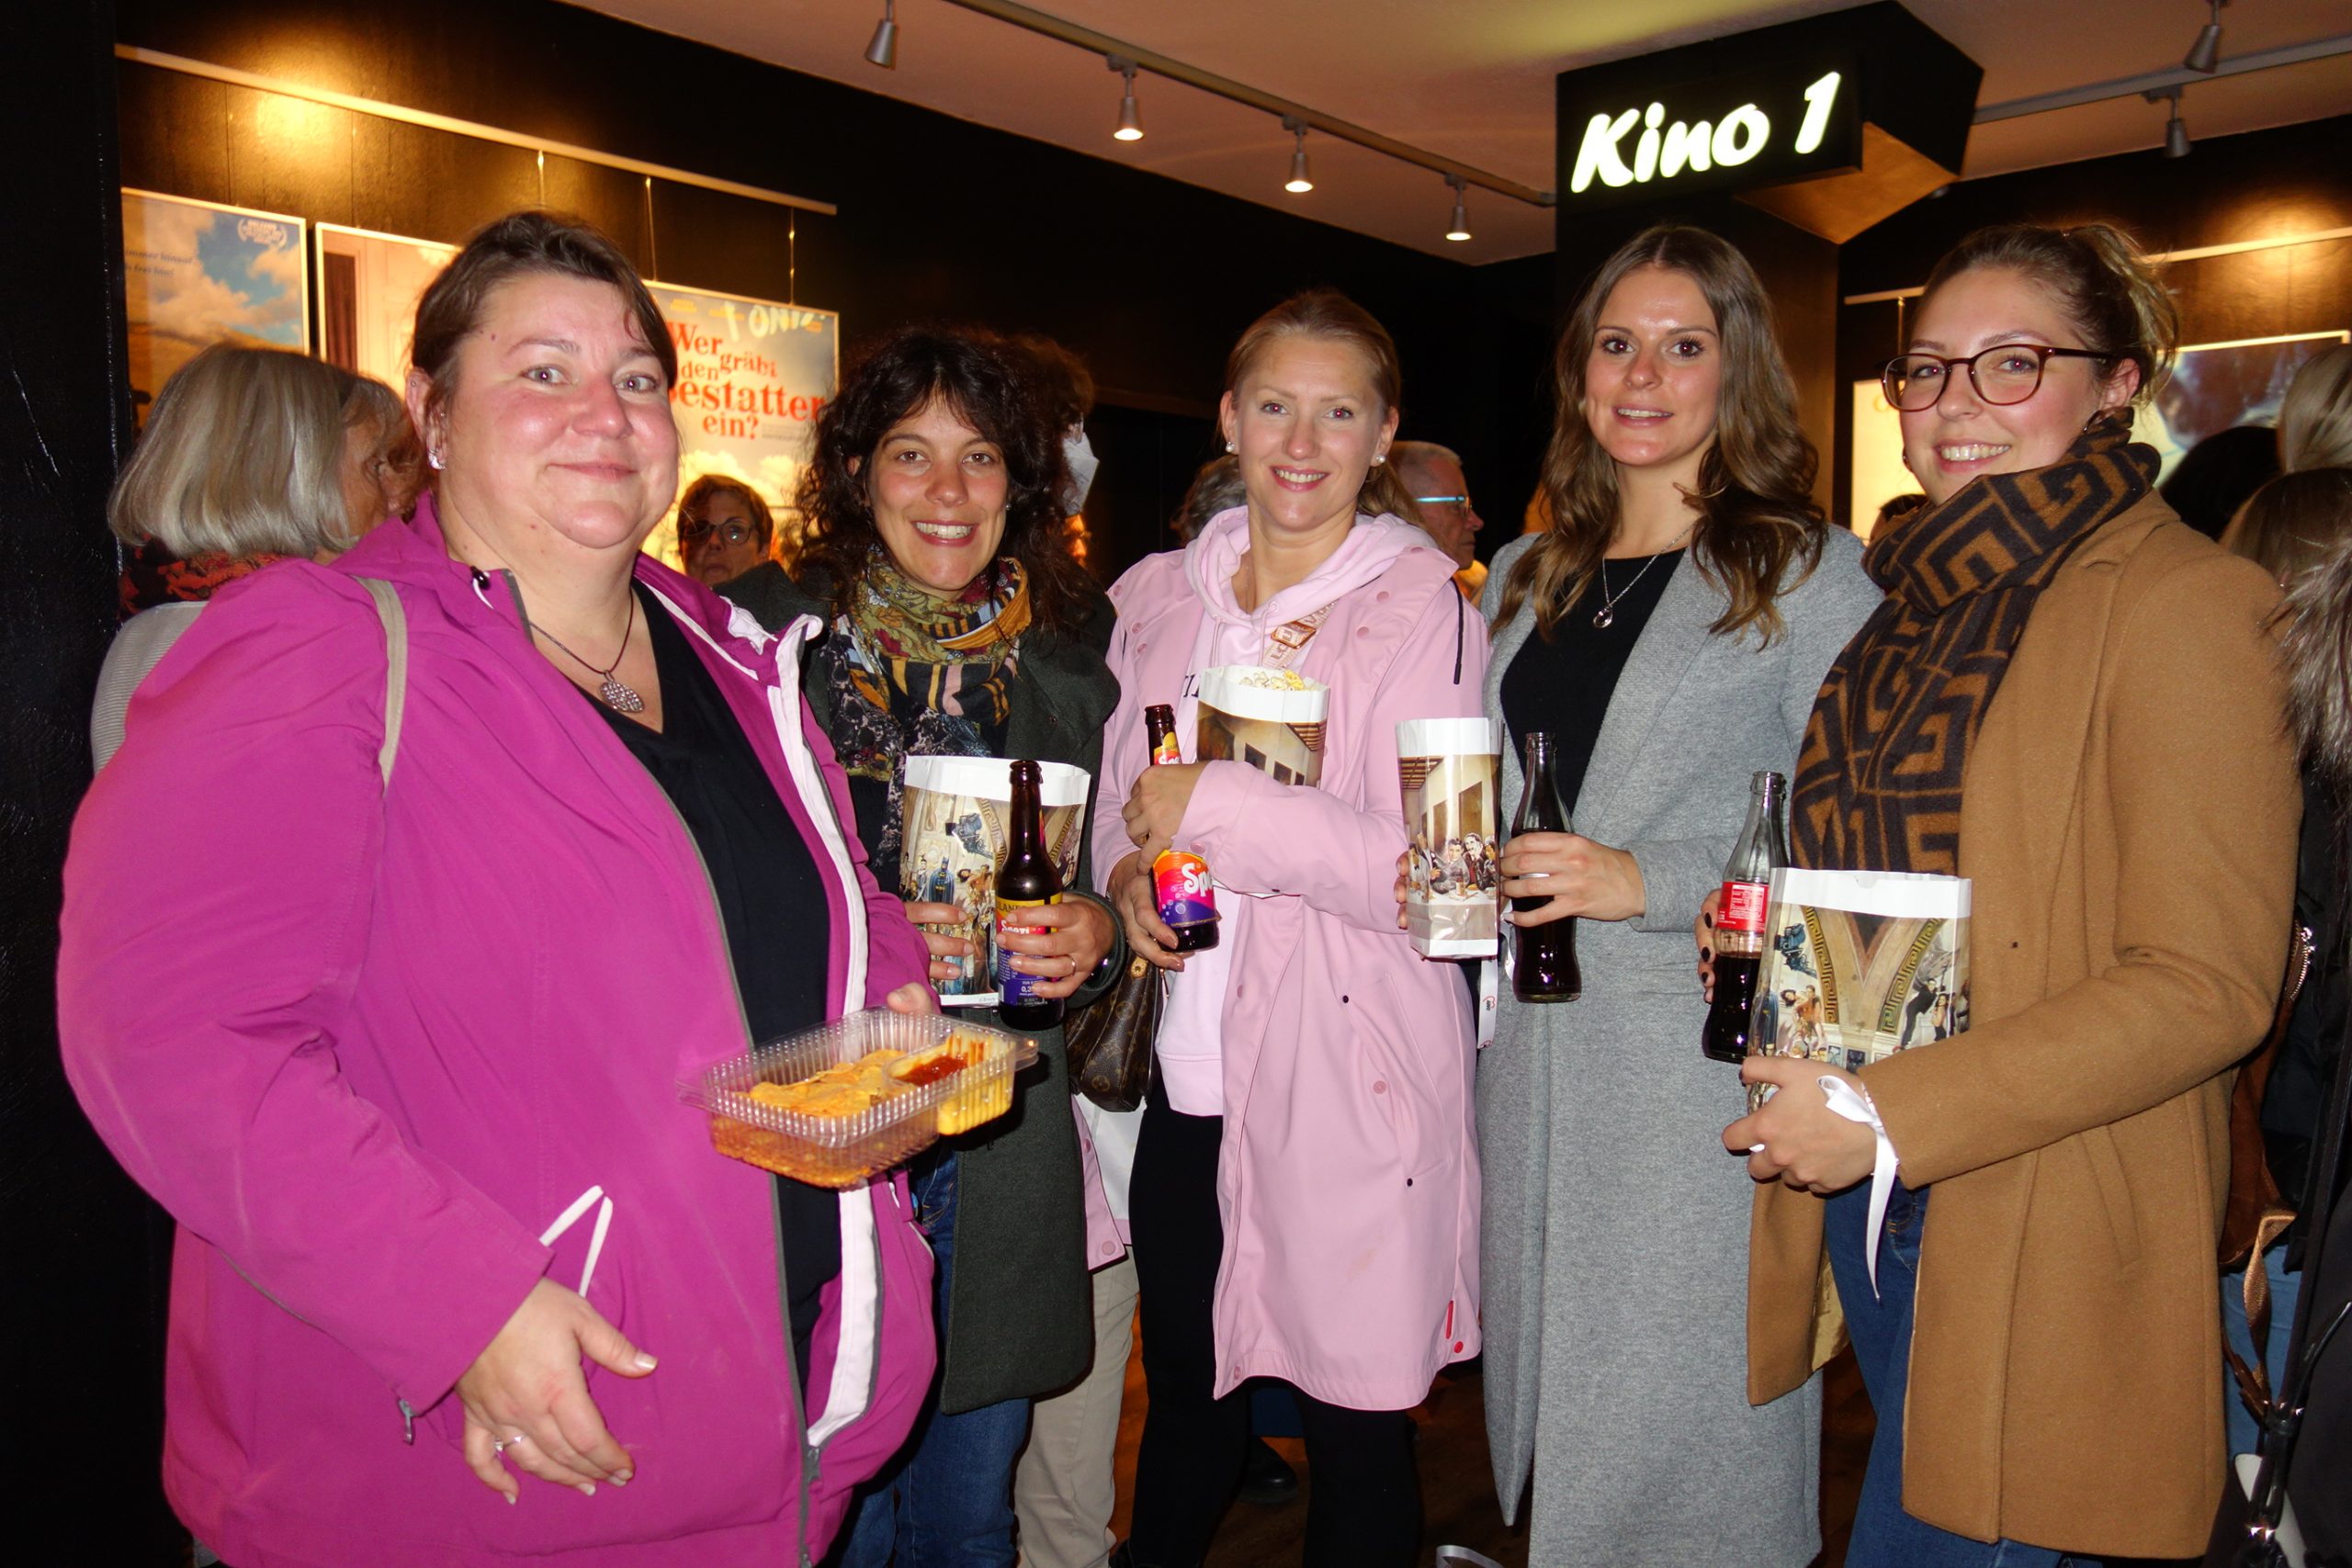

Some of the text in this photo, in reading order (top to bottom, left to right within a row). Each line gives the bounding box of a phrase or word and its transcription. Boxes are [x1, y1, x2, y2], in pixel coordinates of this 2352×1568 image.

[1570, 71, 1841, 194] Kino 1
[668, 321, 724, 356] Wer
[680, 360, 720, 381] den
[719, 351, 778, 378] gräbt
[669, 379, 827, 422] estatter
[702, 412, 759, 440] ein?
